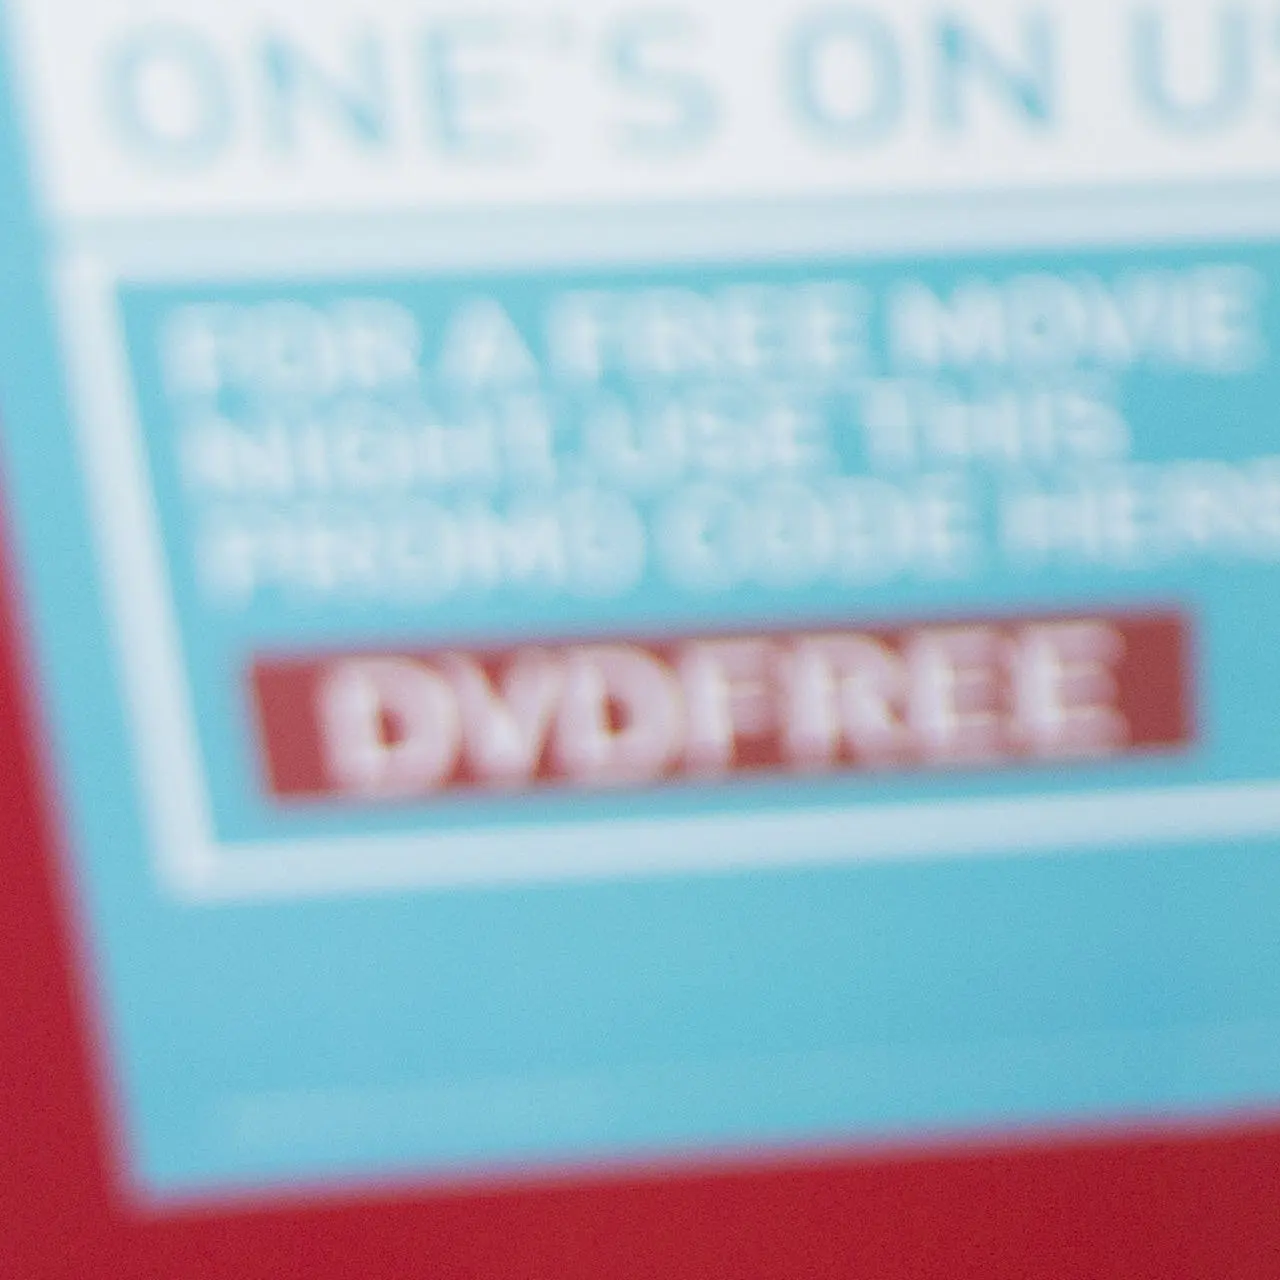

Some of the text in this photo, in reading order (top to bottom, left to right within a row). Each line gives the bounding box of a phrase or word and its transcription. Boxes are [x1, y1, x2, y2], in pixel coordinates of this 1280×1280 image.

[100, 2, 724, 175] ONE'S
[780, 0, 1062, 150] ON
[164, 268, 1263, 394] FOR A FREE MOVIE
[582, 387, 822, 482] USE
[862, 380, 1130, 465] THIS
[198, 492, 646, 606] PROMO
[660, 475, 978, 589] CODE
[320, 622, 1126, 799] DVDFREE
